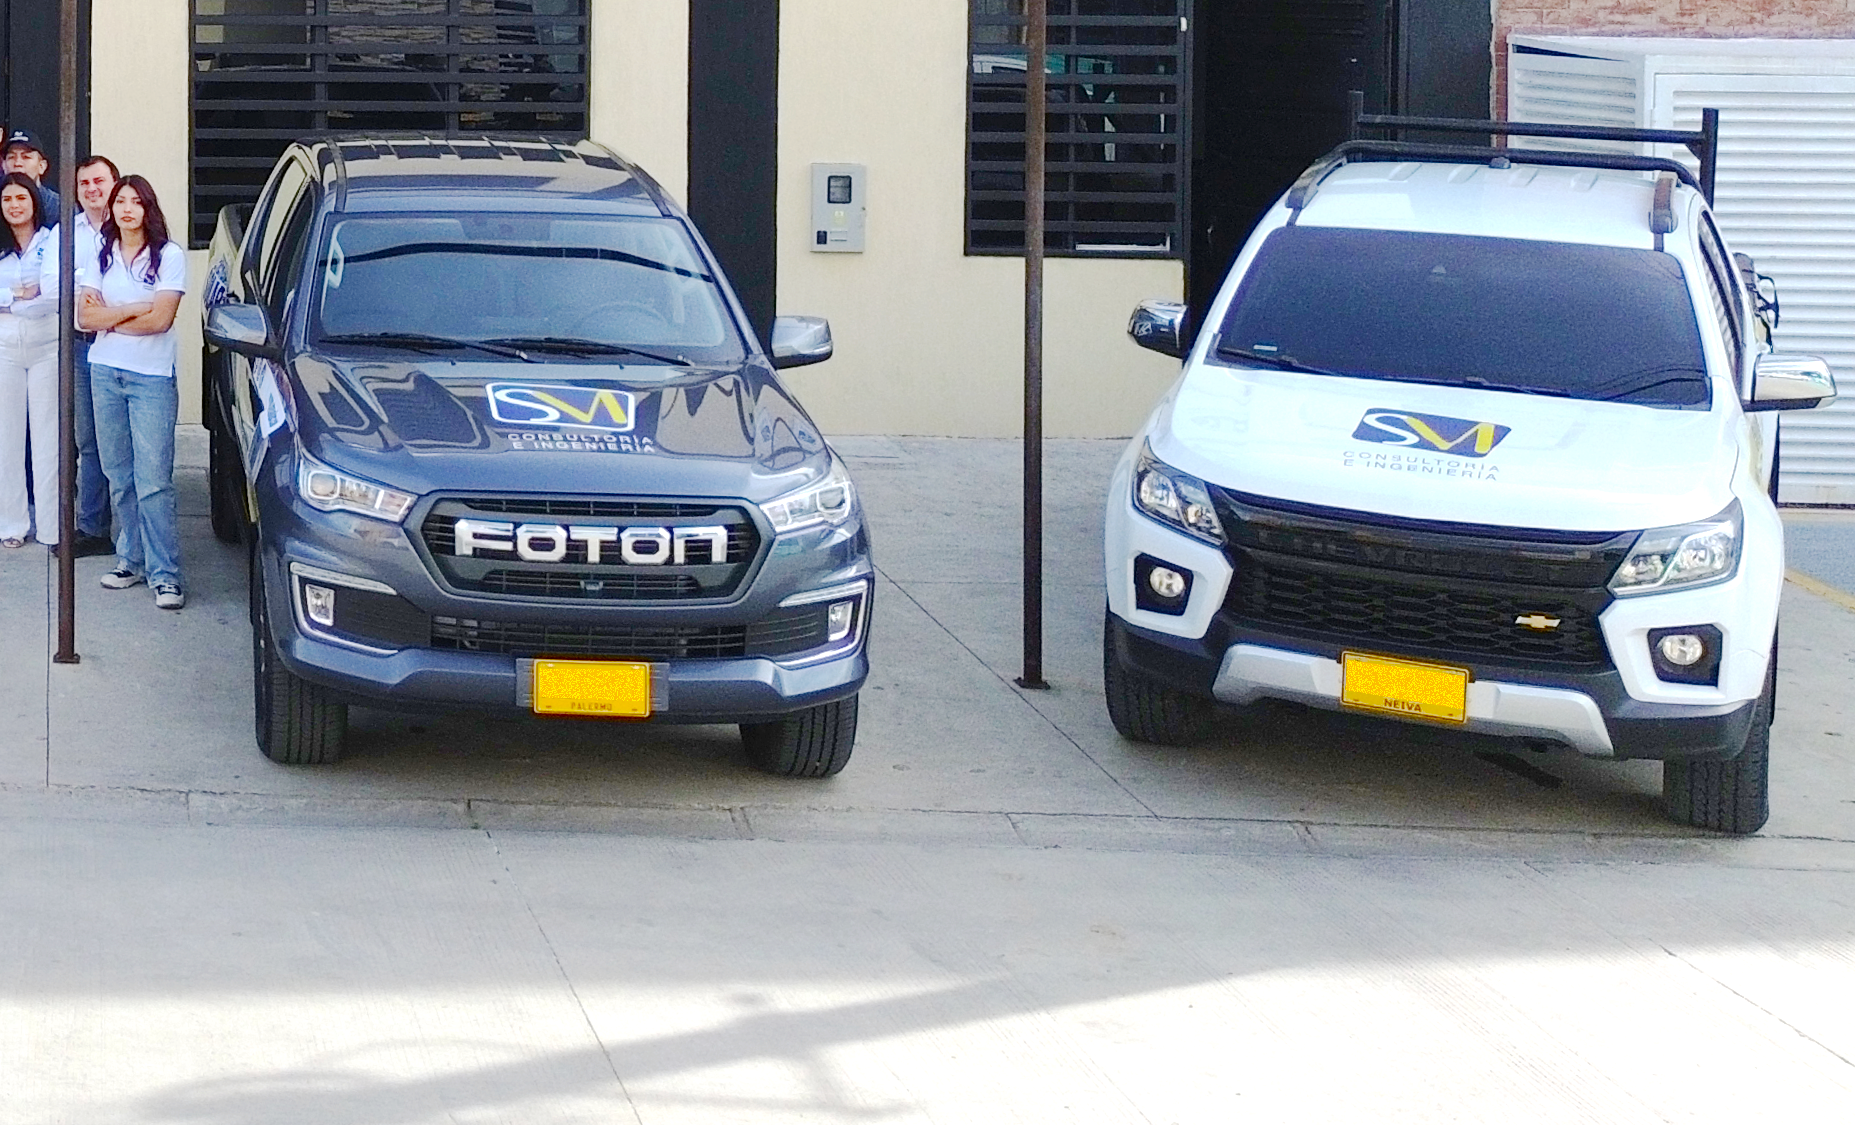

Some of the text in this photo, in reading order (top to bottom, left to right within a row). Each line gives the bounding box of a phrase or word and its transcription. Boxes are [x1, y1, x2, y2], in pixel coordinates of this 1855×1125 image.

[454, 518, 728, 565] FOTON
[570, 701, 613, 711] PALERMO
[1384, 698, 1423, 713] NEIVA
